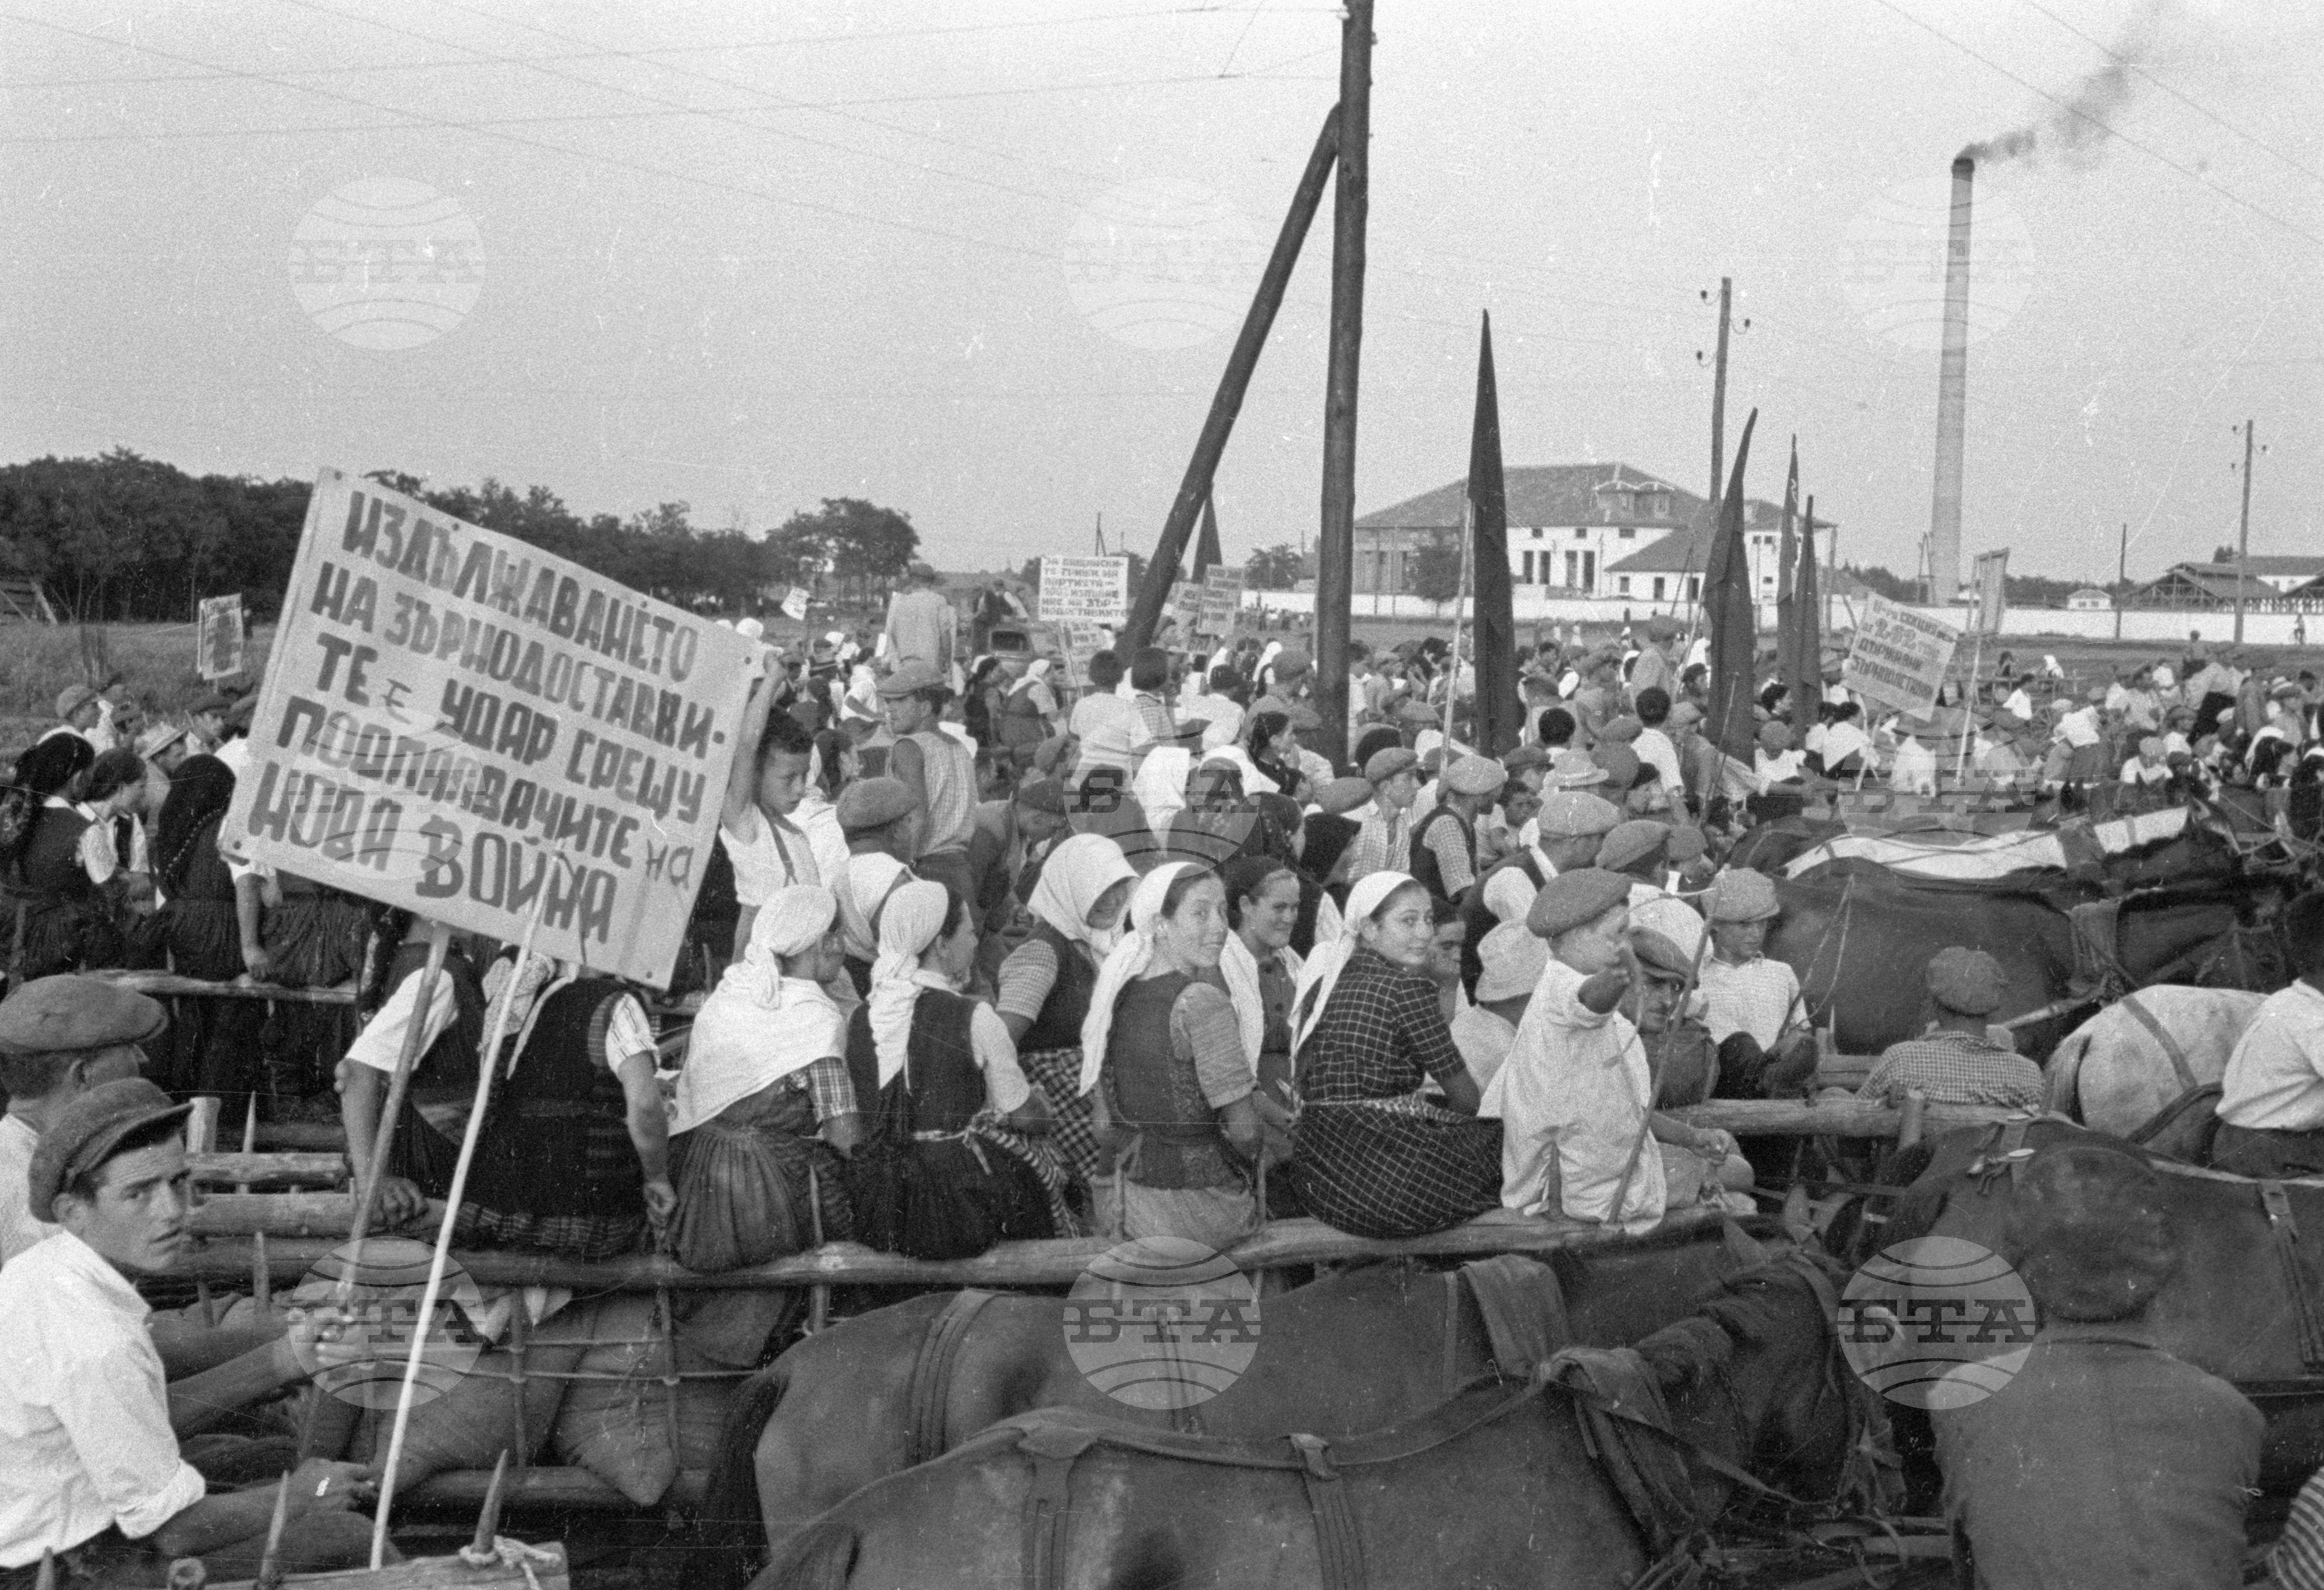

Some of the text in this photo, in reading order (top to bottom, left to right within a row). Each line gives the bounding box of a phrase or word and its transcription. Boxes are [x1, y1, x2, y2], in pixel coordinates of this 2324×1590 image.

[311, 562, 378, 633] НА
[342, 490, 698, 682] ИЗДЪЛЖАВАНЕТО
[276, 695, 639, 869] ПОДПАЛВАЧИТЕ
[317, 632, 378, 706] ТЕ
[436, 679, 558, 765] УДАР
[565, 727, 706, 824] СРЕЩУ
[248, 760, 618, 945] НОВА ВОЙНА
